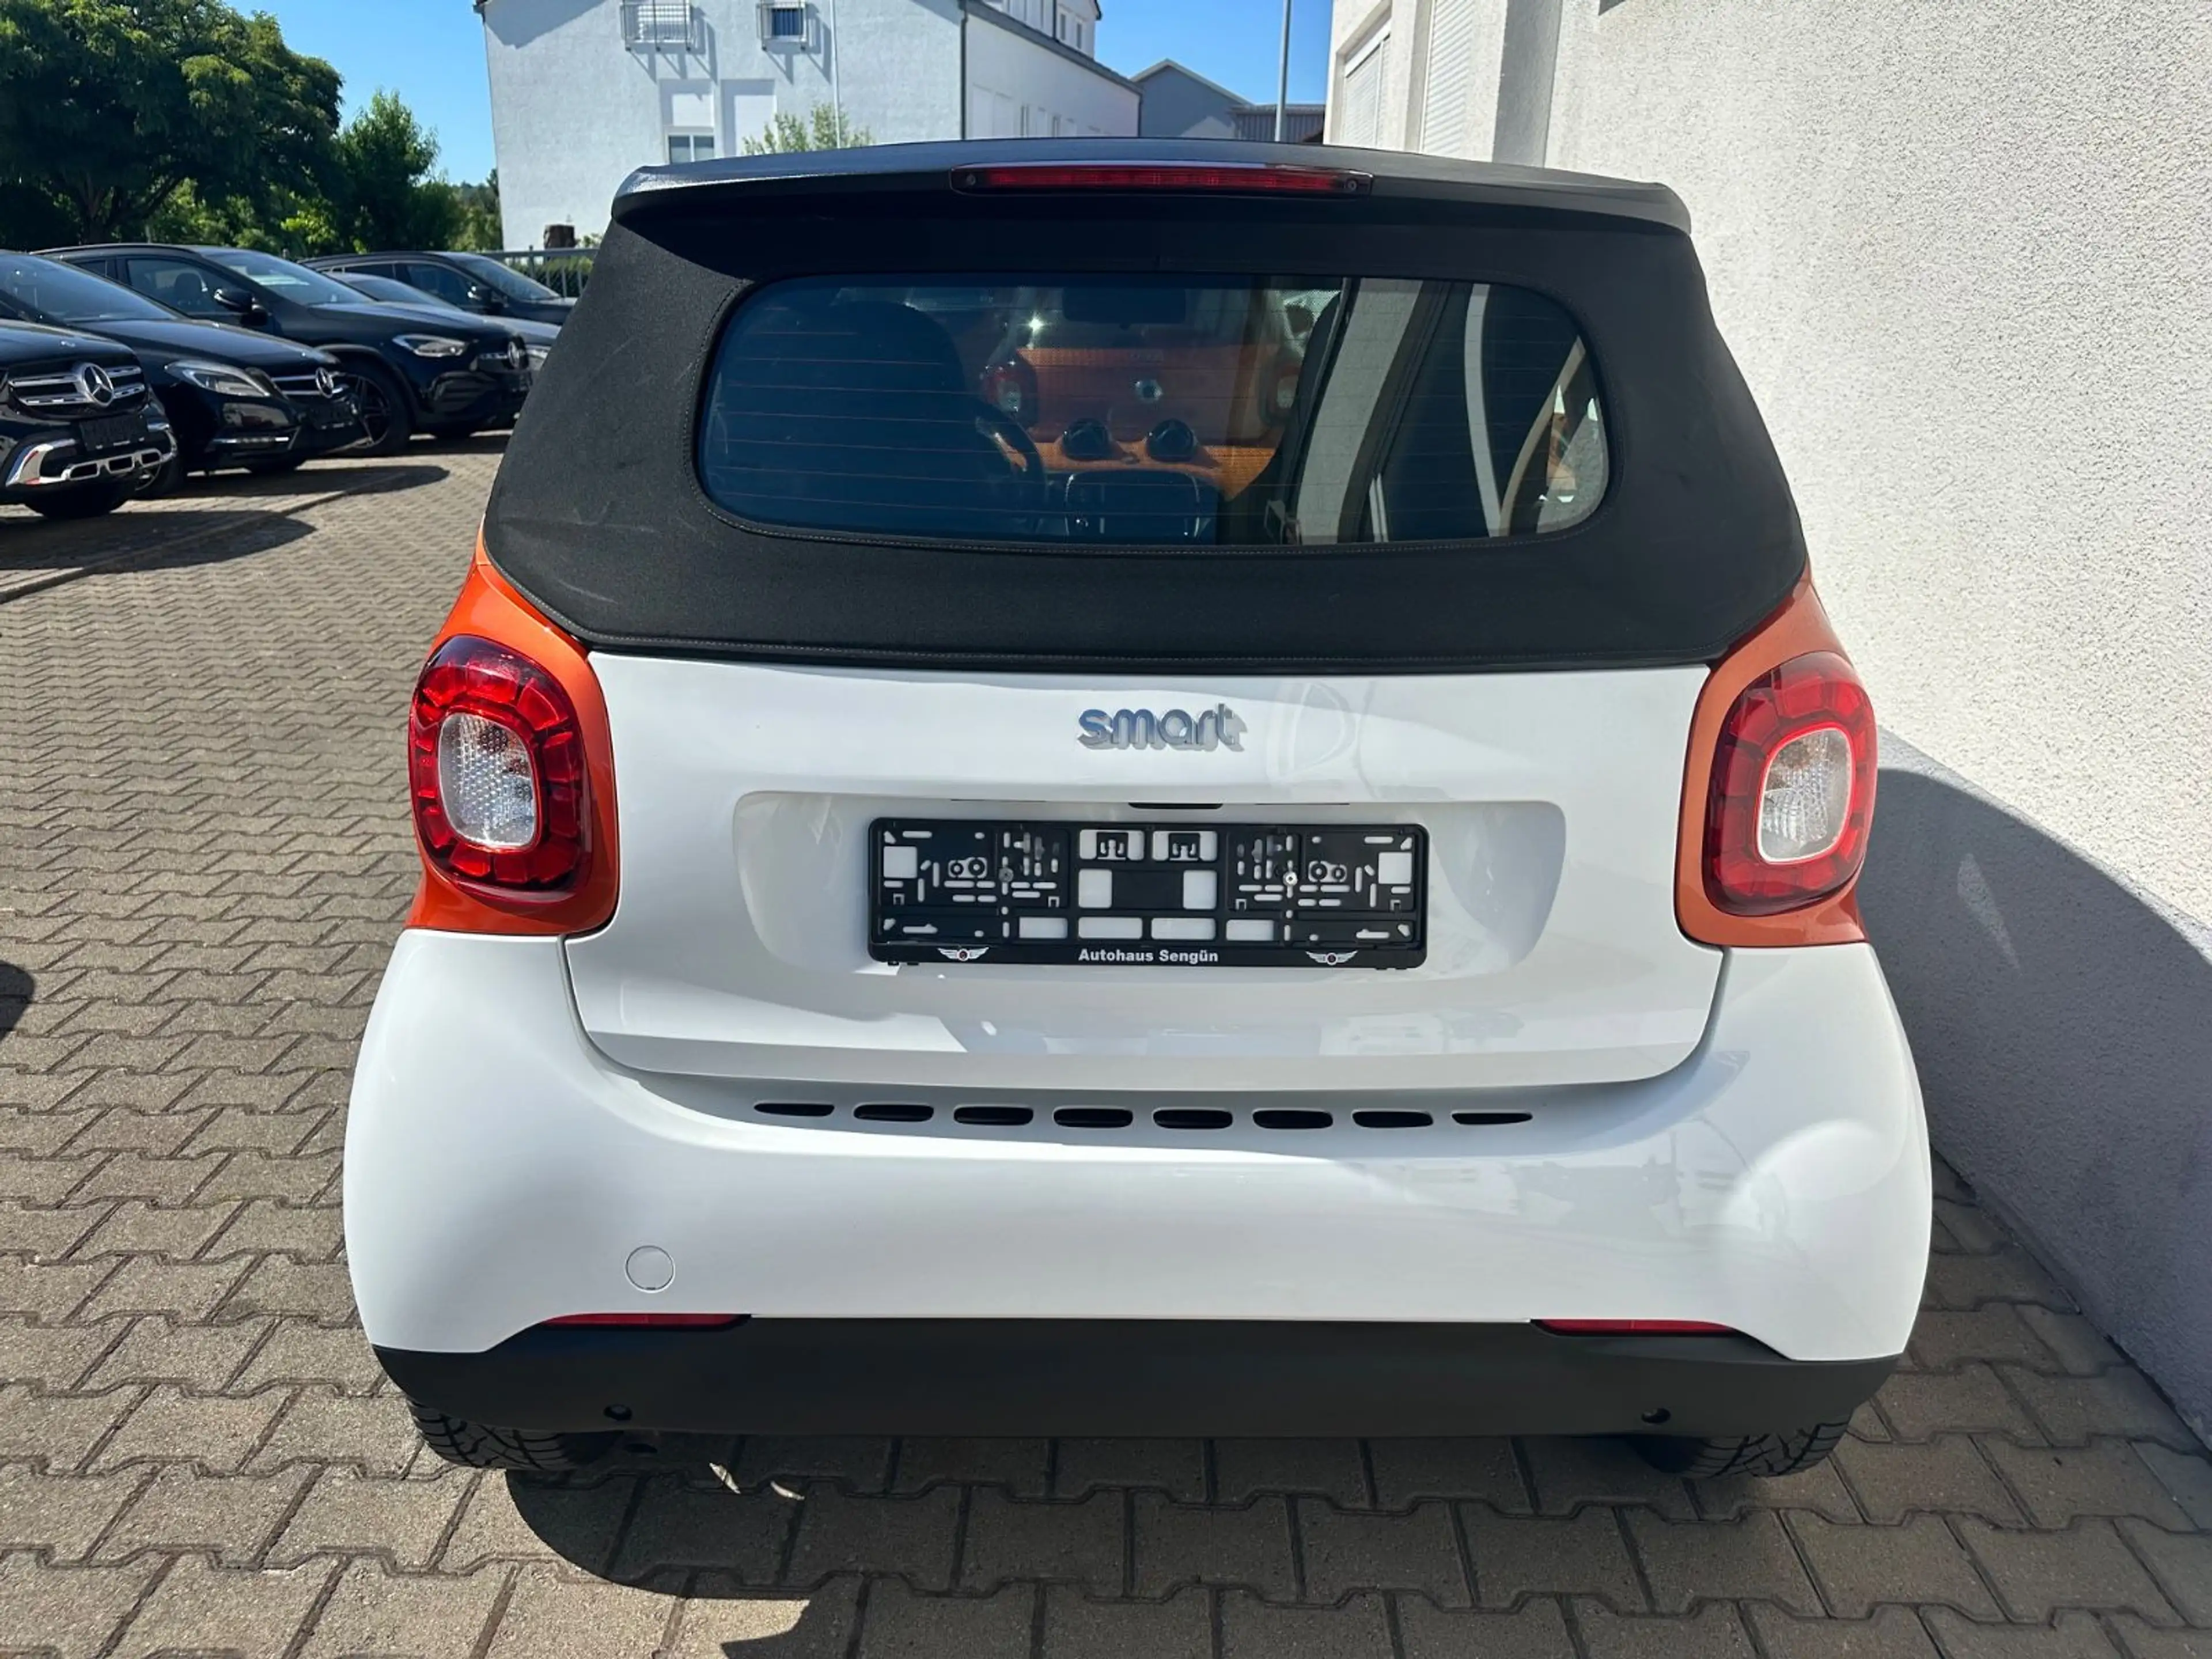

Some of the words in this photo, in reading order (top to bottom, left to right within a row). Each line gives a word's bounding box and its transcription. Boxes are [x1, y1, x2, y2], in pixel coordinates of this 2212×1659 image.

[1078, 702, 1240, 748] smart
[1078, 948, 1153, 961] Autohaus
[1158, 949, 1218, 964] Sengün
